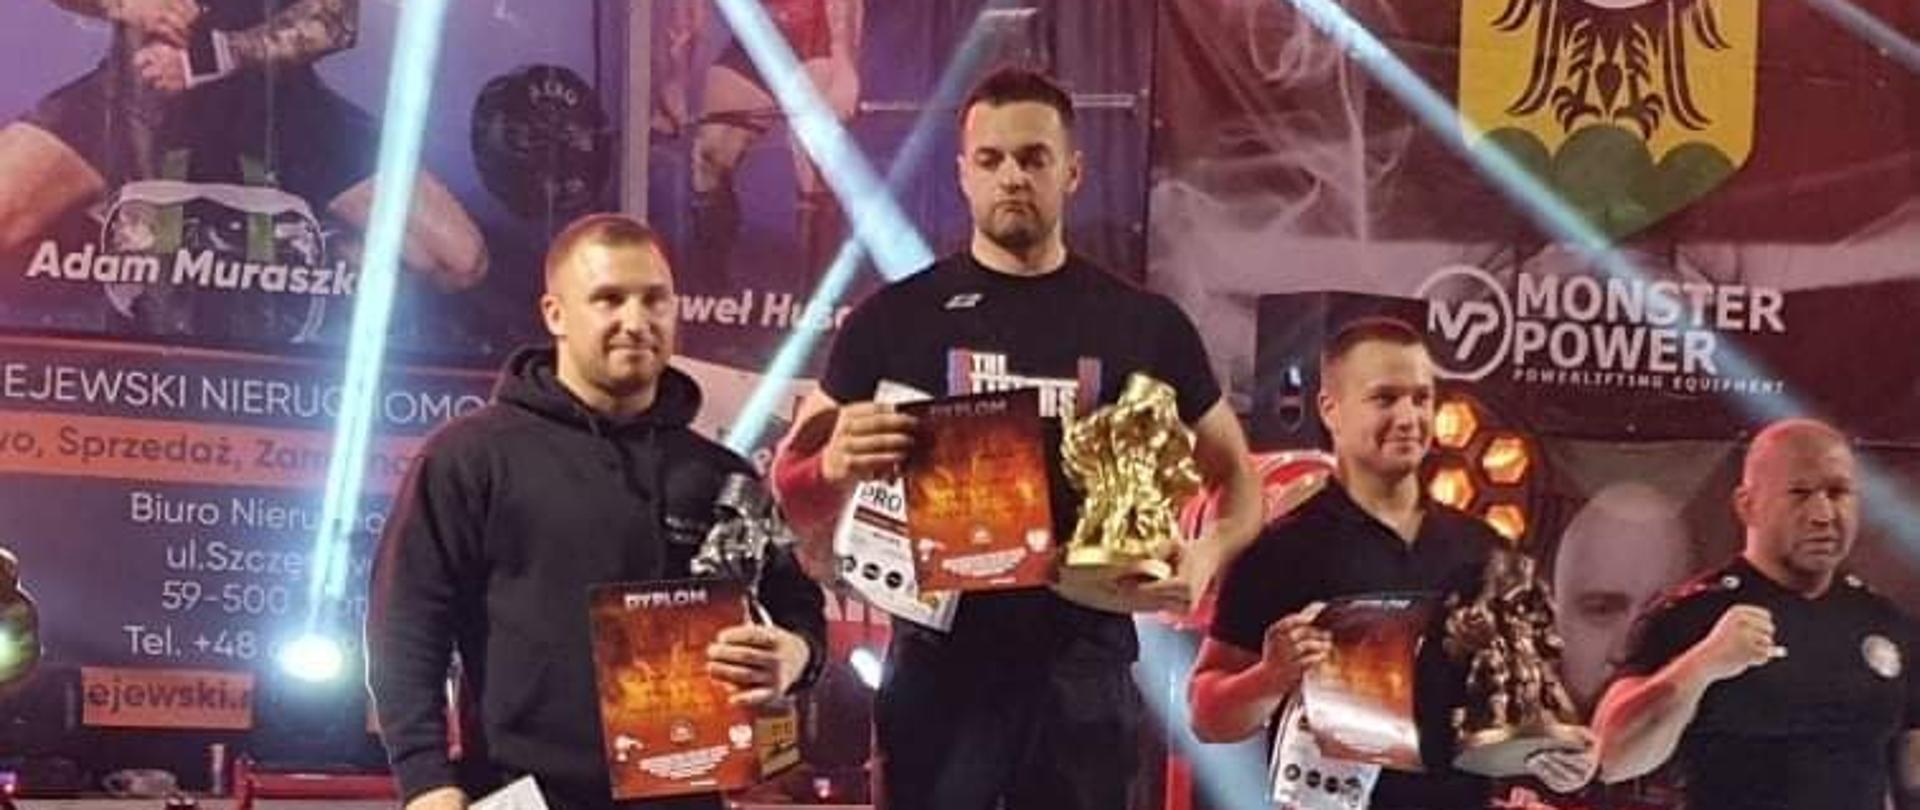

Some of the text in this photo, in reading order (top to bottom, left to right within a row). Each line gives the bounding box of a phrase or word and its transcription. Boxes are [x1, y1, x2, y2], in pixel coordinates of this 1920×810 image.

[26, 241, 359, 296] Adam Muraszk
[681, 288, 753, 325] weł
[1516, 272, 1786, 332] MONSTER
[1513, 320, 1718, 375] POWER
[4, 364, 187, 408] EJEWSKI
[1512, 368, 1785, 395] POWERLIFTING EQUIPMENT
[59, 426, 243, 473] Sprzedaż,
[130, 492, 386, 534] Biuro Nieruo
[161, 581, 289, 615] 59-500
[124, 625, 182, 657] Tel.
[193, 631, 257, 659] +48
